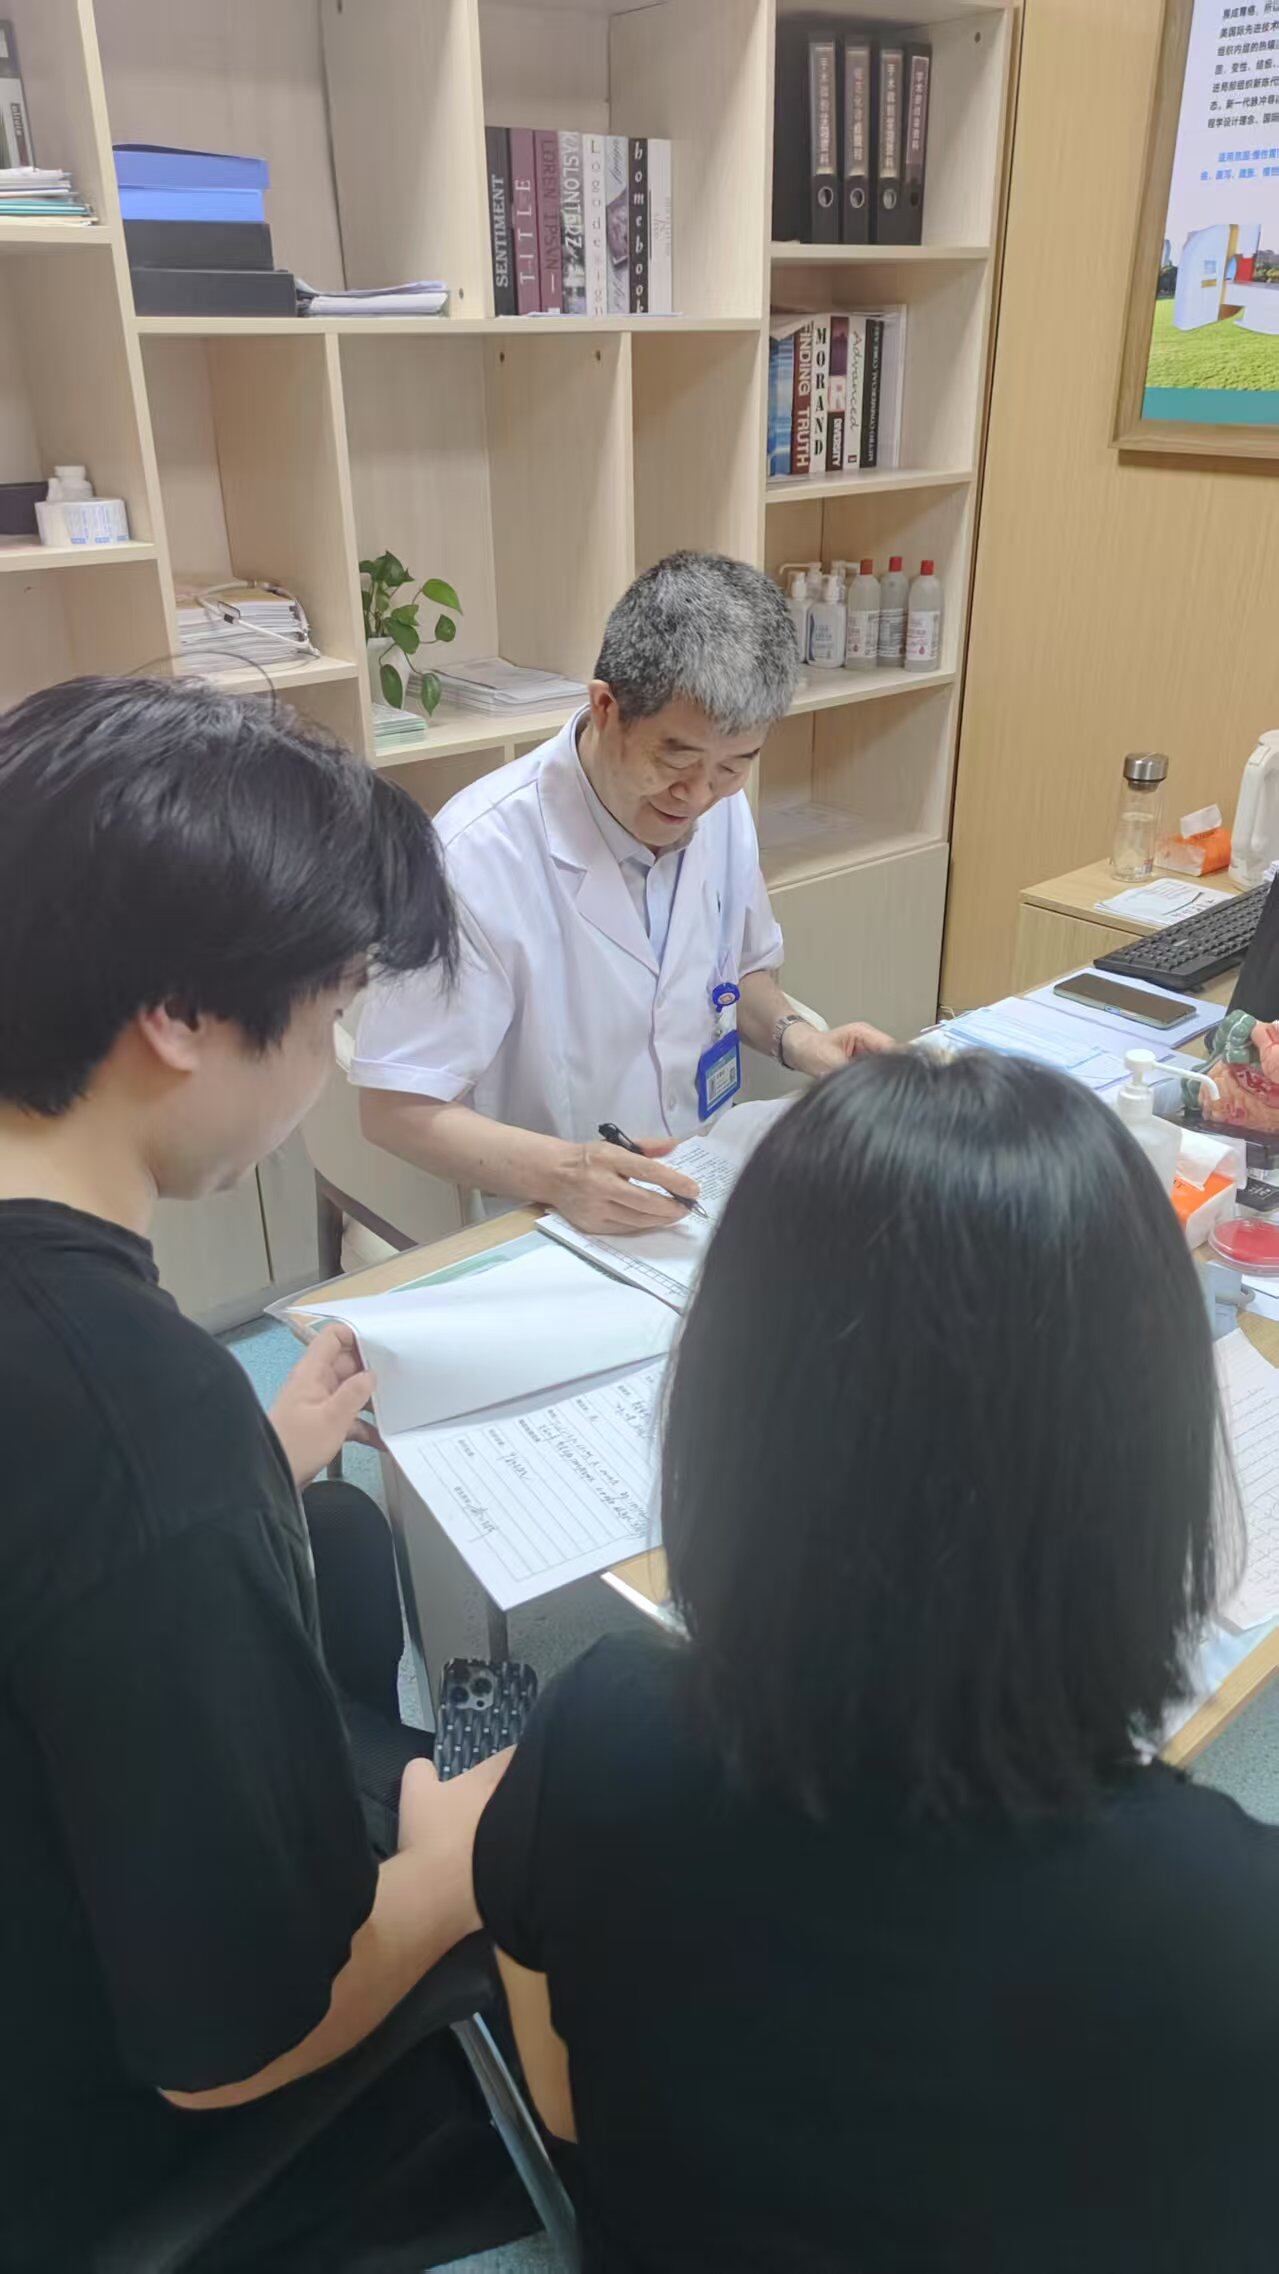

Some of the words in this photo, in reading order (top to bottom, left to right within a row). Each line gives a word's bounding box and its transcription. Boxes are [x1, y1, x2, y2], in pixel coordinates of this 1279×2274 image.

[491, 174, 509, 287] SENTIMENT
[515, 179, 535, 284] TITLE
[814, 327, 826, 456] MORAND
[849, 330, 863, 432] Advanced
[797, 407, 811, 467] TRUTH
